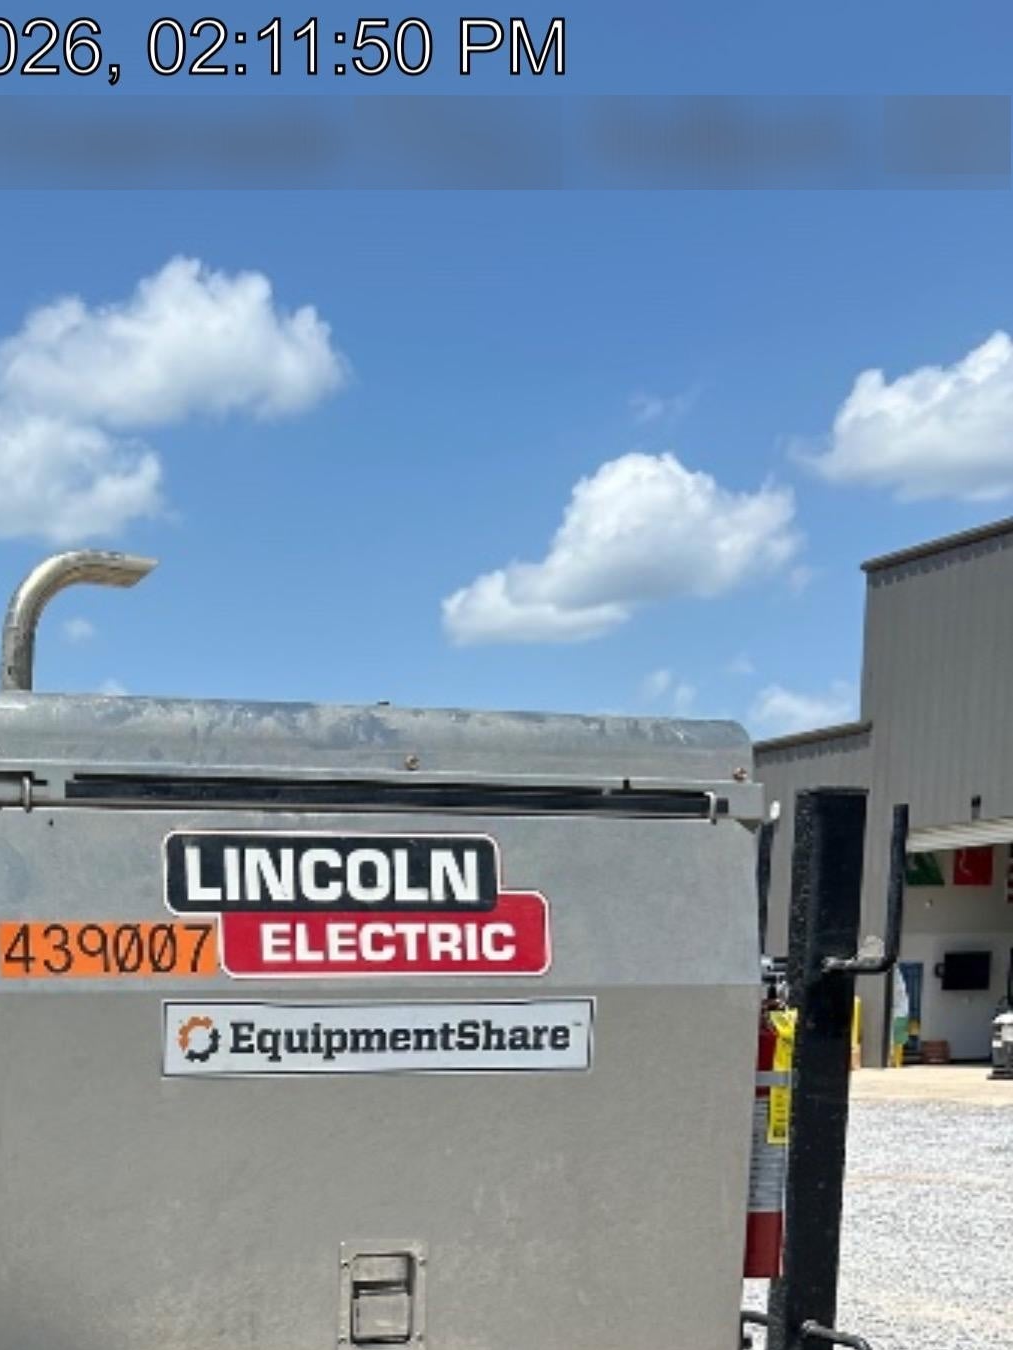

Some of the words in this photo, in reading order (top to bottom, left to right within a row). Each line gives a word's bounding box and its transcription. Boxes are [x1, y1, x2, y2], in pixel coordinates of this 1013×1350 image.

[186, 847, 477, 900] LINCOLN
[5, 923, 211, 973] 439007
[261, 923, 515, 961] ELECTRIC
[229, 1020, 570, 1062] EquipmentShare
